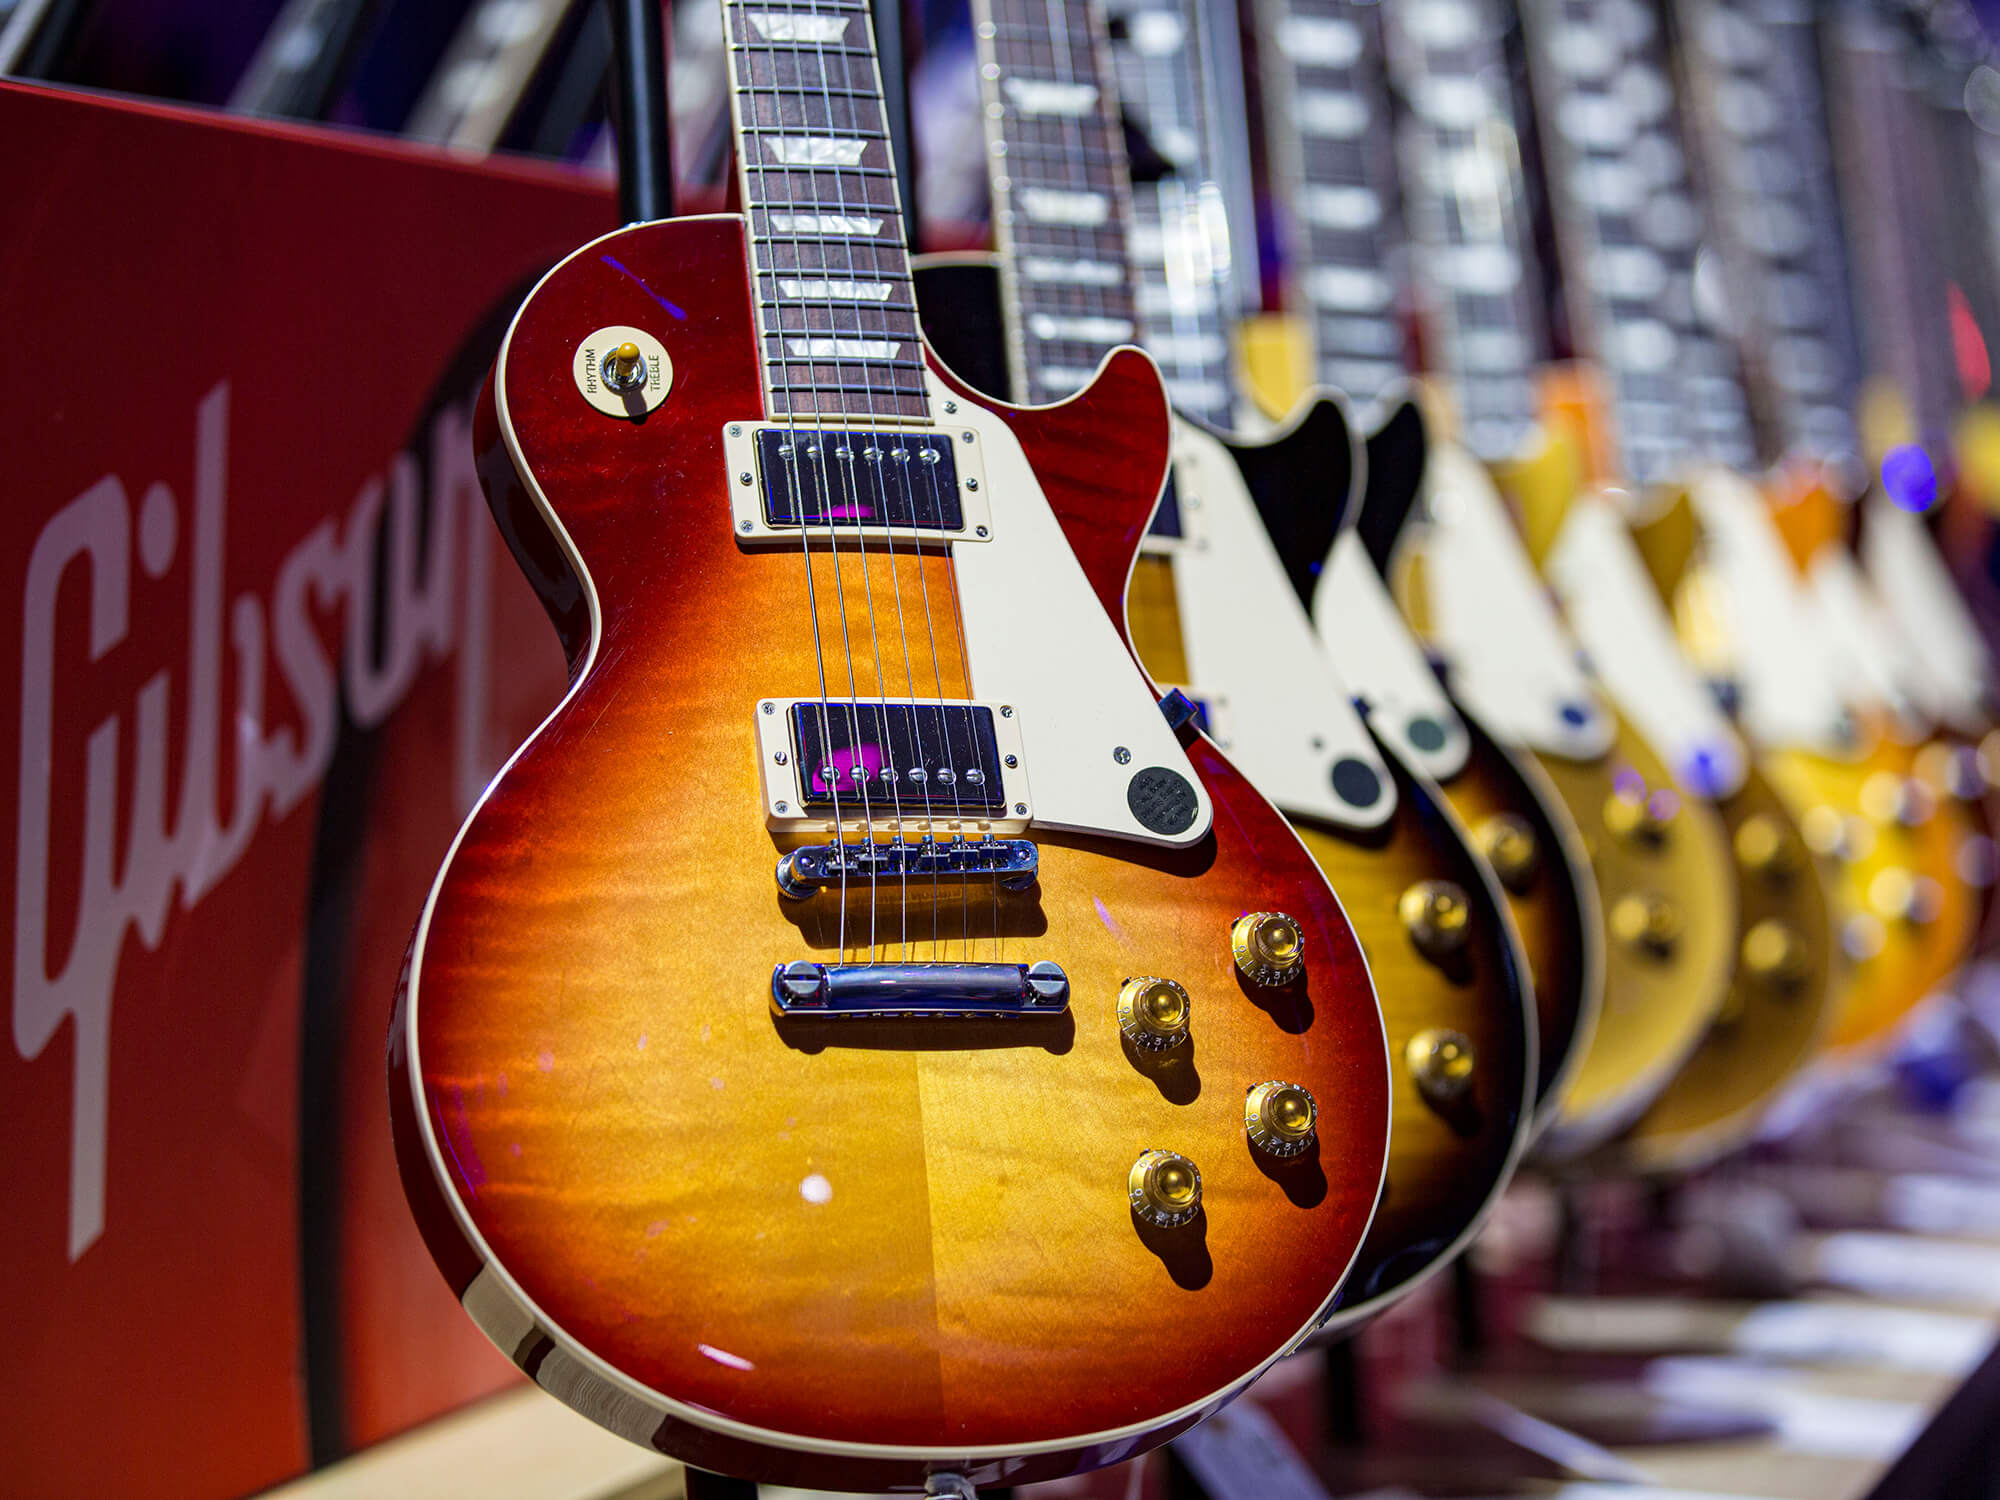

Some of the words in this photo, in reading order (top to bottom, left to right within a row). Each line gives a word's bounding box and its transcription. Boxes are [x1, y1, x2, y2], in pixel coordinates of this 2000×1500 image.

[585, 348, 597, 394] RHYTHM
[648, 355, 660, 392] TREBLE
[13, 379, 496, 1264] Gibson
